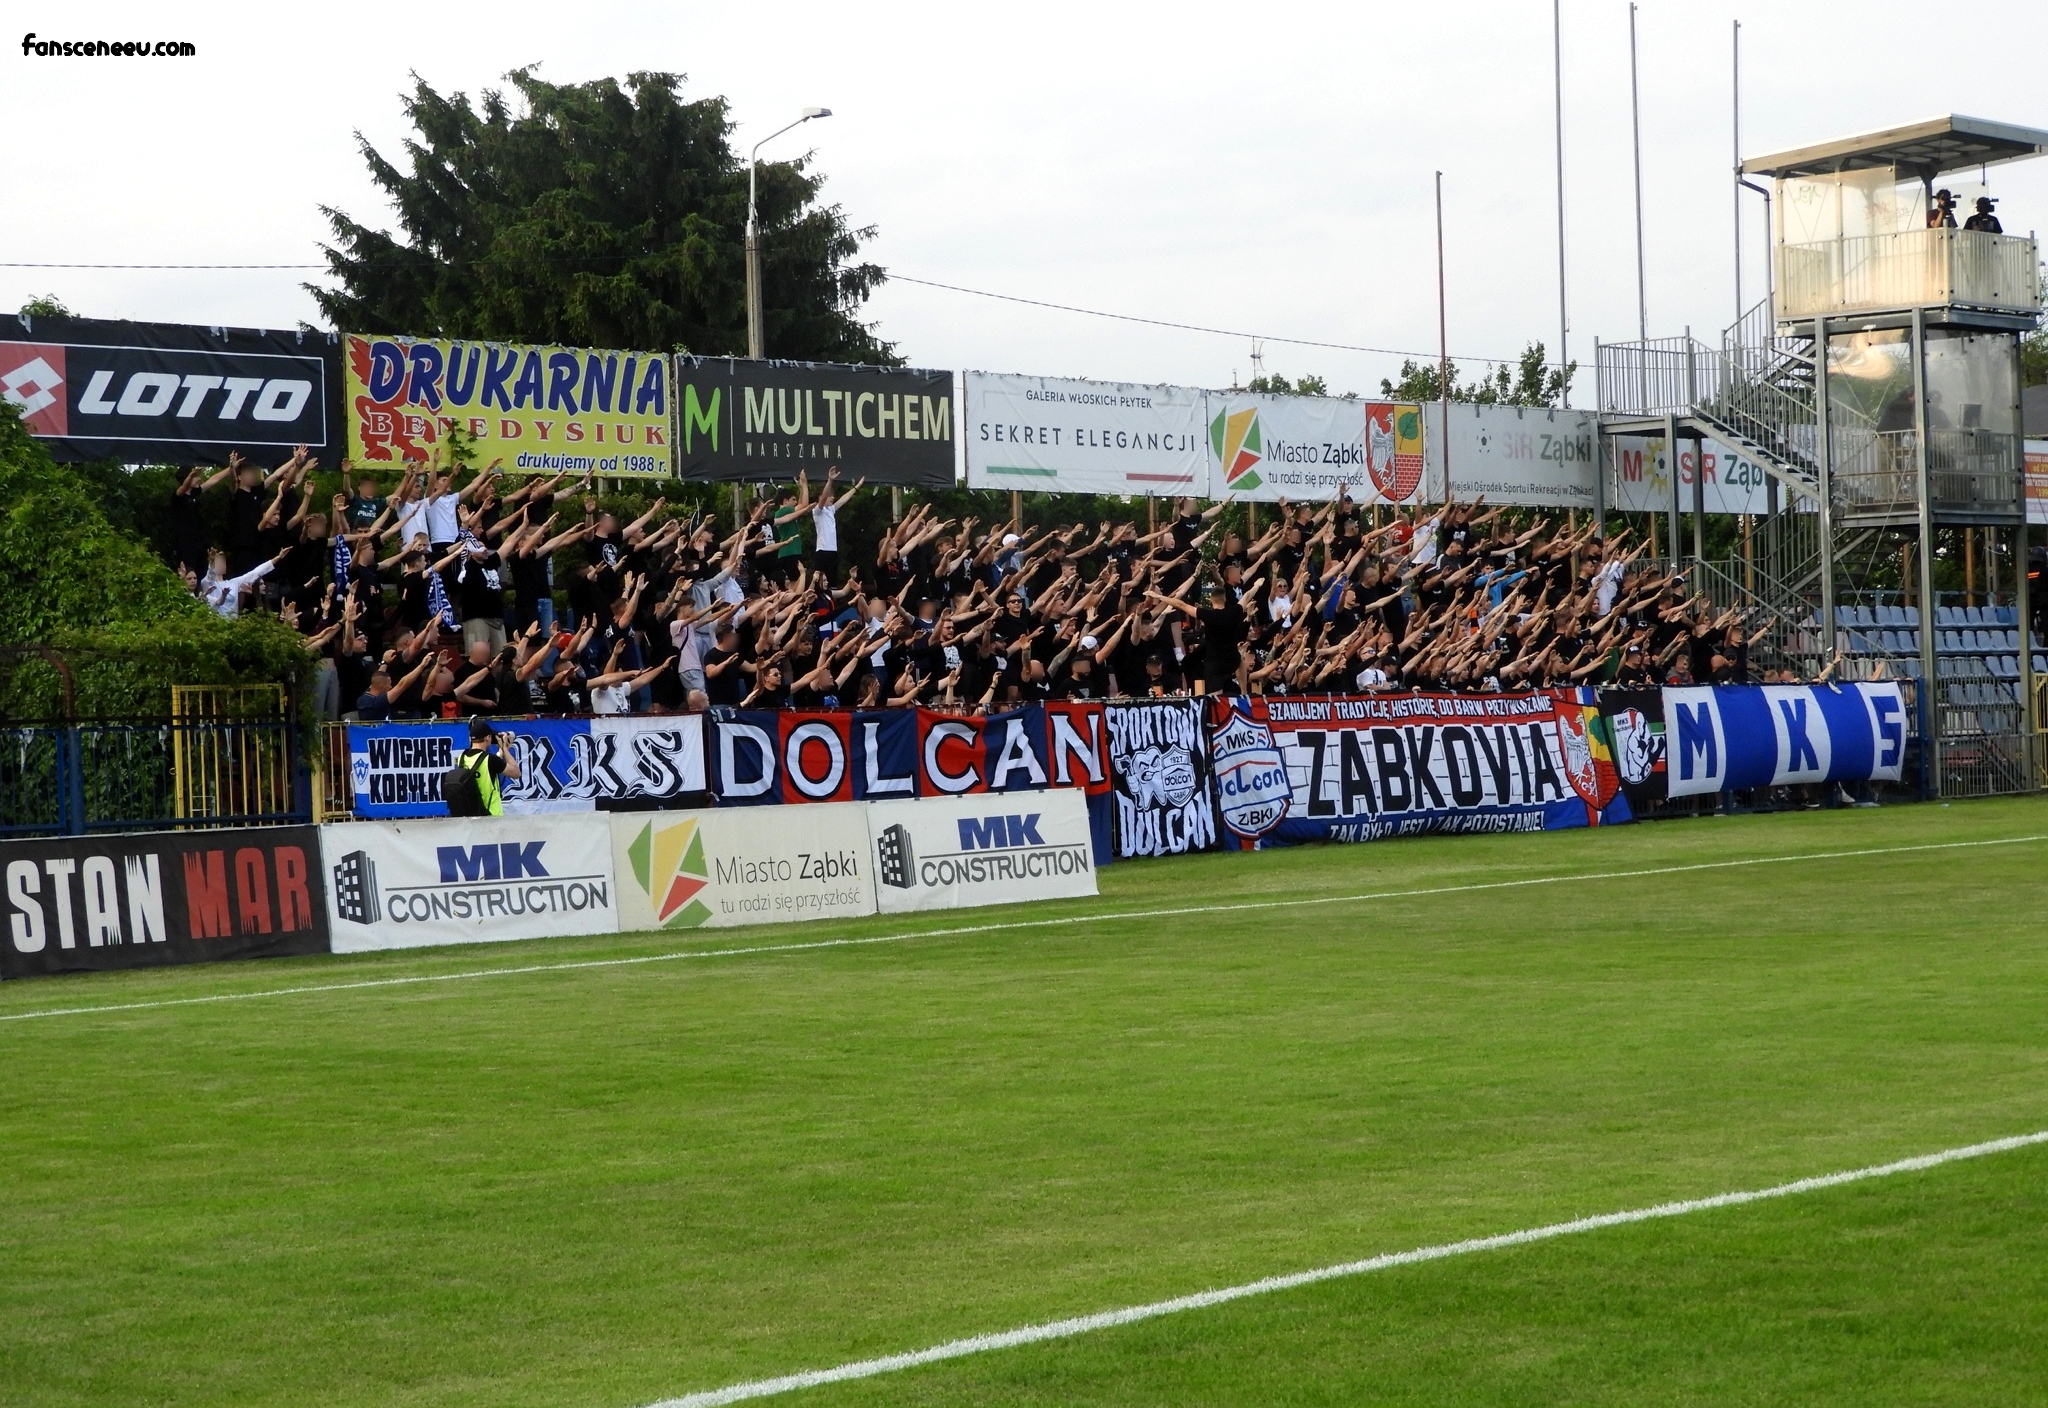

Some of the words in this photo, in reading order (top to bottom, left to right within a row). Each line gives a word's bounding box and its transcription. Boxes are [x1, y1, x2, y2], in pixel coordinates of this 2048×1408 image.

[368, 340, 666, 416] DRUKARNIA
[78, 370, 313, 422] LOTTO
[1026, 389, 1066, 403] GALERIA
[1068, 393, 1117, 407] WŁOSKICH
[1120, 396, 1152, 409] PŁYTEK
[369, 412, 667, 445] BENEDYSIUK
[744, 387, 950, 441] MULTICHEM
[746, 442, 842, 459] WARSZAWA
[980, 423, 1062, 446] SEKRET
[1076, 428, 1195, 452] ELEGANCJI
[1267, 439, 1318, 464] Miasto
[1322, 442, 1364, 468] Ząbki
[1540, 434, 1591, 468] Ząbki
[517, 451, 594, 473] drukujemy
[600, 451, 618, 471] od
[622, 455, 655, 472] 1988
[658, 459, 668, 473] r.
[1724, 454, 1768, 494] Ząb
[1269, 472, 1278, 484] tu
[1280, 471, 1302, 485] rodzi
[1305, 471, 1317, 488] się
[1319, 471, 1364, 489] przyszłość
[1449, 481, 1473, 495] Miejski
[1474, 480, 1503, 493] Ośrodek
[1504, 482, 1526, 496] Sportu
[1530, 483, 1562, 497] Rekreacji
[1268, 702, 1332, 721] SZANUJEMY
[1438, 698, 1454, 716] DO
[1456, 698, 1485, 717] BARW
[1105, 698, 1206, 771] SPORTOWY
[1226, 731, 1255, 750] MKS
[1675, 695, 1903, 781] MKS
[368, 737, 453, 769] WICHER
[716, 711, 1108, 798] DOLCAN
[1296, 722, 1568, 822] ZĄBKOVIA
[957, 813, 1046, 851] MK
[1115, 775, 1216, 857] DOLCAN
[1330, 823, 1358, 843] TAK
[436, 841, 551, 883] MK
[716, 855, 792, 885] Miasto
[798, 850, 858, 884] Ząbki
[921, 849, 1089, 887] CONSTRUCTION
[6, 853, 167, 953] STAN
[183, 845, 313, 940] MAR
[387, 881, 609, 923] CONSTRUCTION
[721, 898, 735, 914] tu
[739, 894, 771, 912] rodzi
[775, 892, 793, 913] się
[796, 886, 862, 913] przyszłość
